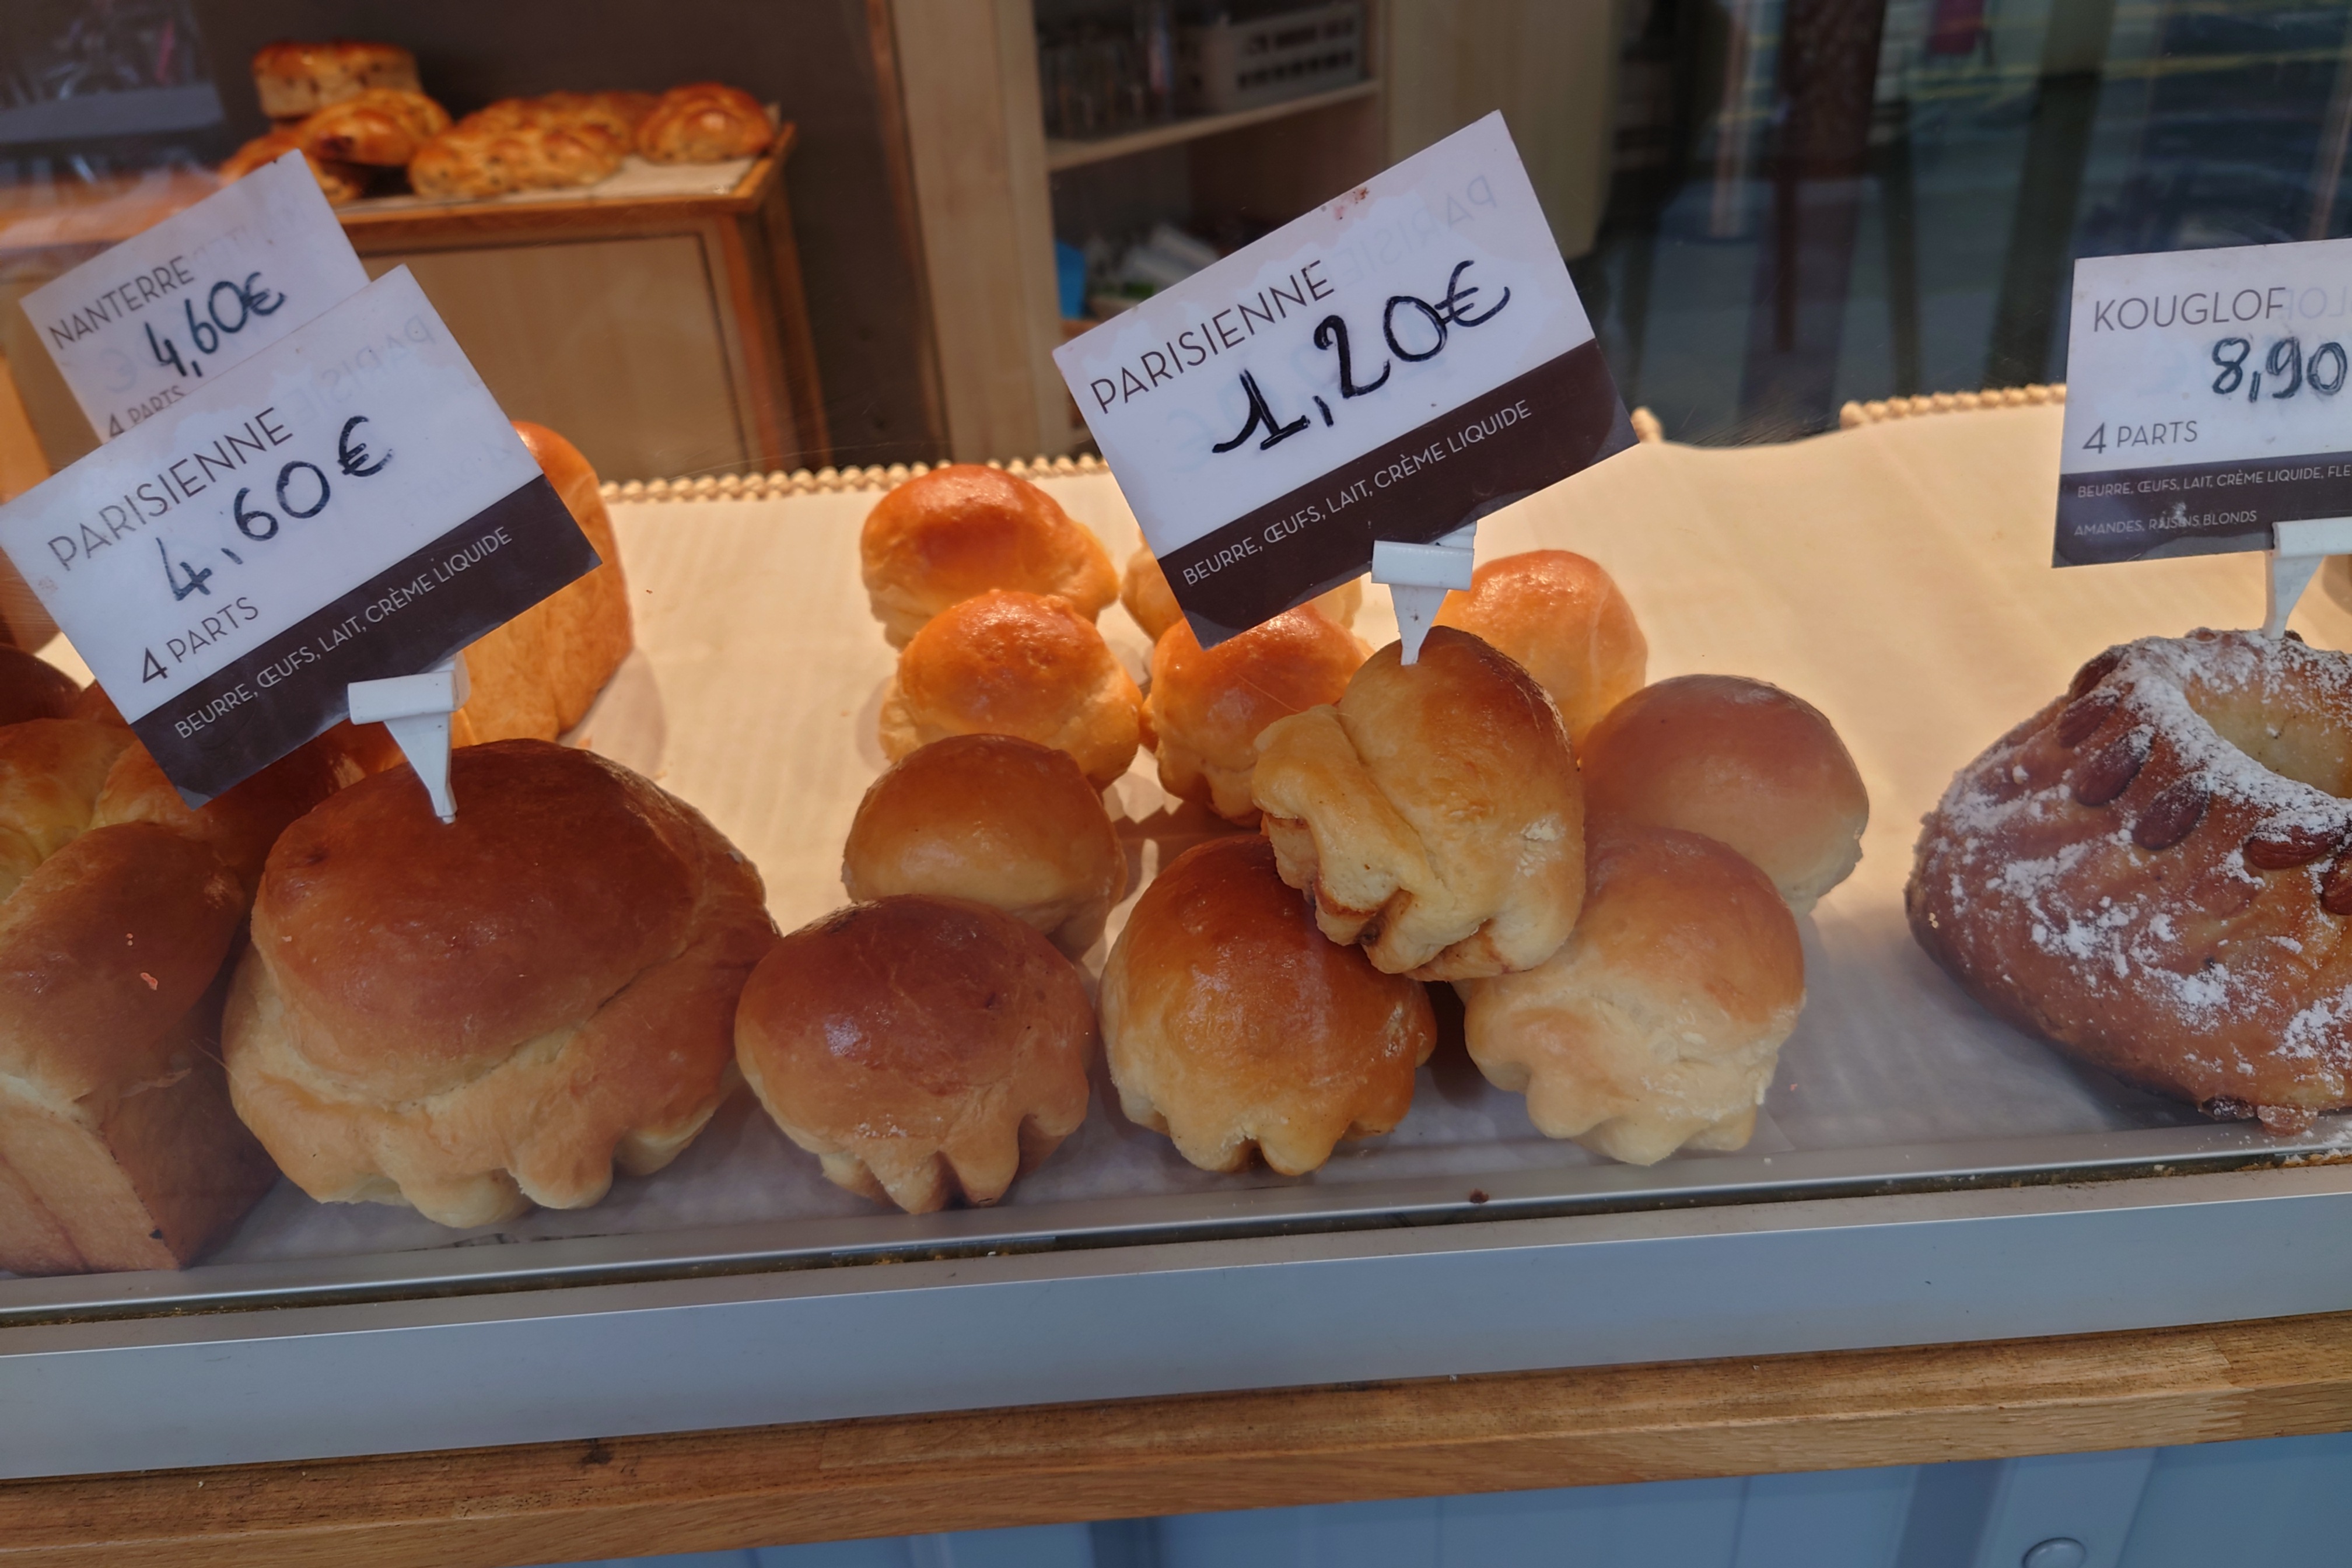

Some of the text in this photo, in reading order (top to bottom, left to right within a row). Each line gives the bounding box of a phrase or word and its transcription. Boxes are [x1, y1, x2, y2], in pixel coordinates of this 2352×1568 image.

[48, 256, 194, 349] NANTERRE
[145, 271, 288, 377] 4,60€
[1090, 260, 1335, 414] PARISIENNE
[2093, 286, 2286, 332] KOUGLOF
[1212, 260, 1511, 453] 1,20€
[2211, 336, 2348, 403] 8,90
[2082, 420, 2199, 454] 4 PARTS
[2217, 470, 2263, 487] CRÈME
[2328, 464, 2352, 478] FLE
[48, 407, 293, 570] PARISIENNE
[1183, 400, 1532, 586] BEURRE, ŒUFS, LAIT, CRÈME LIQUIDE
[2203, 510, 2257, 526] BLONDS
[142, 597, 259, 684] 4 PARTS
[174, 526, 513, 740] BEURRE, ŒUFS, LAIT, CRÈME LIQUIDE
